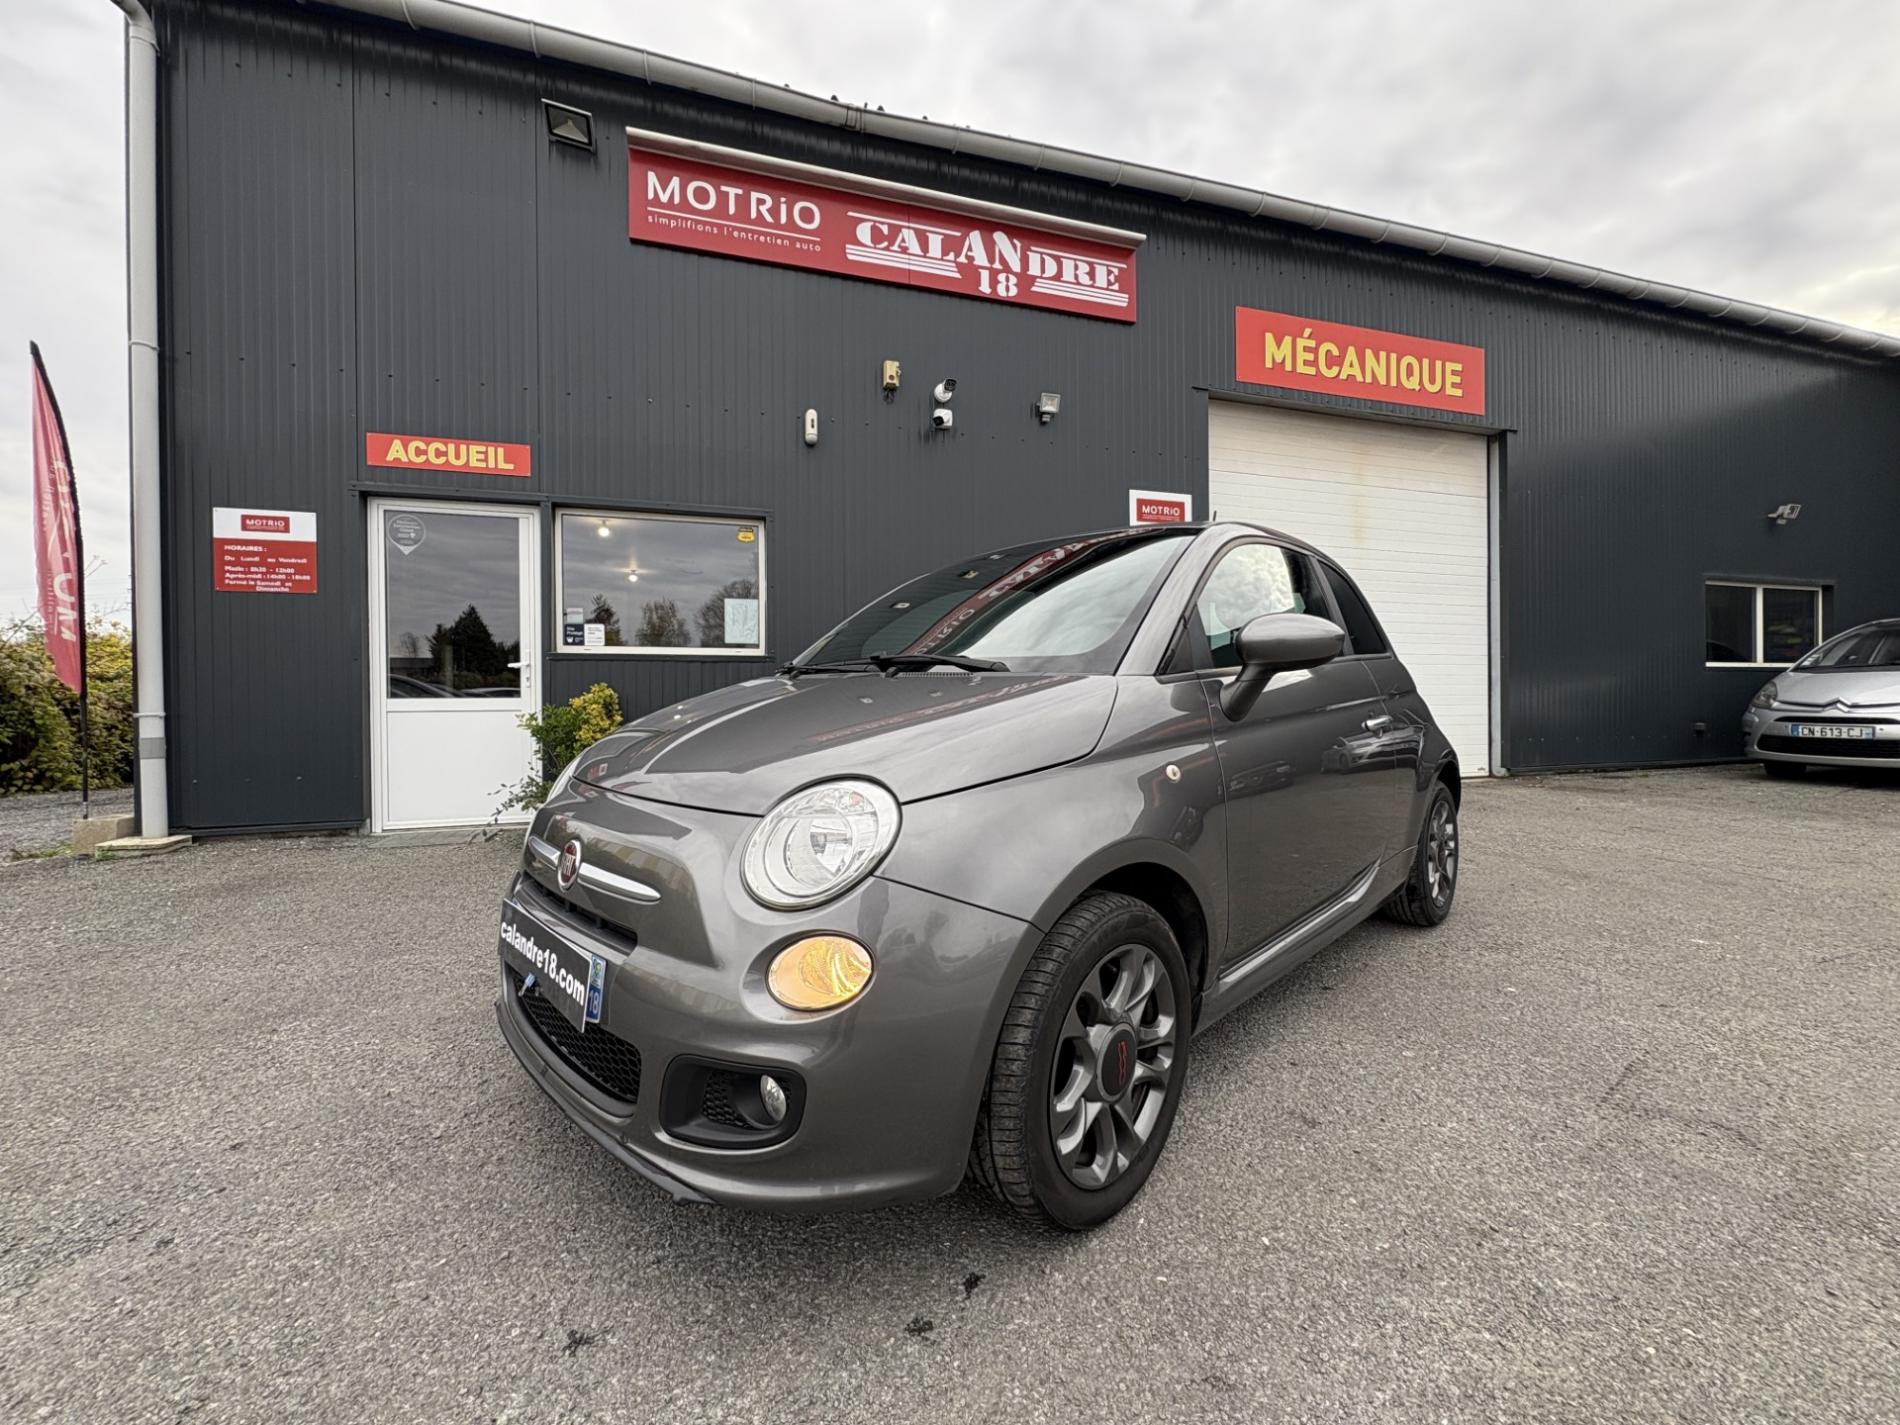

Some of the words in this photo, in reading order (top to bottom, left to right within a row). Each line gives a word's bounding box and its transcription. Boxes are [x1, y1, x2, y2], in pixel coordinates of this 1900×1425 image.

[648, 215, 718, 235] simplifions
[724, 227, 790, 247] l'entretien
[795, 240, 821, 252] auto
[855, 221, 1120, 290] CALANDRE
[978, 268, 1019, 297] 18
[1264, 328, 1464, 398] MÉCANIQUE
[386, 439, 515, 470] ACCUEIL
[500, 921, 586, 1006] calandre18.com
[589, 989, 600, 1015] 18
